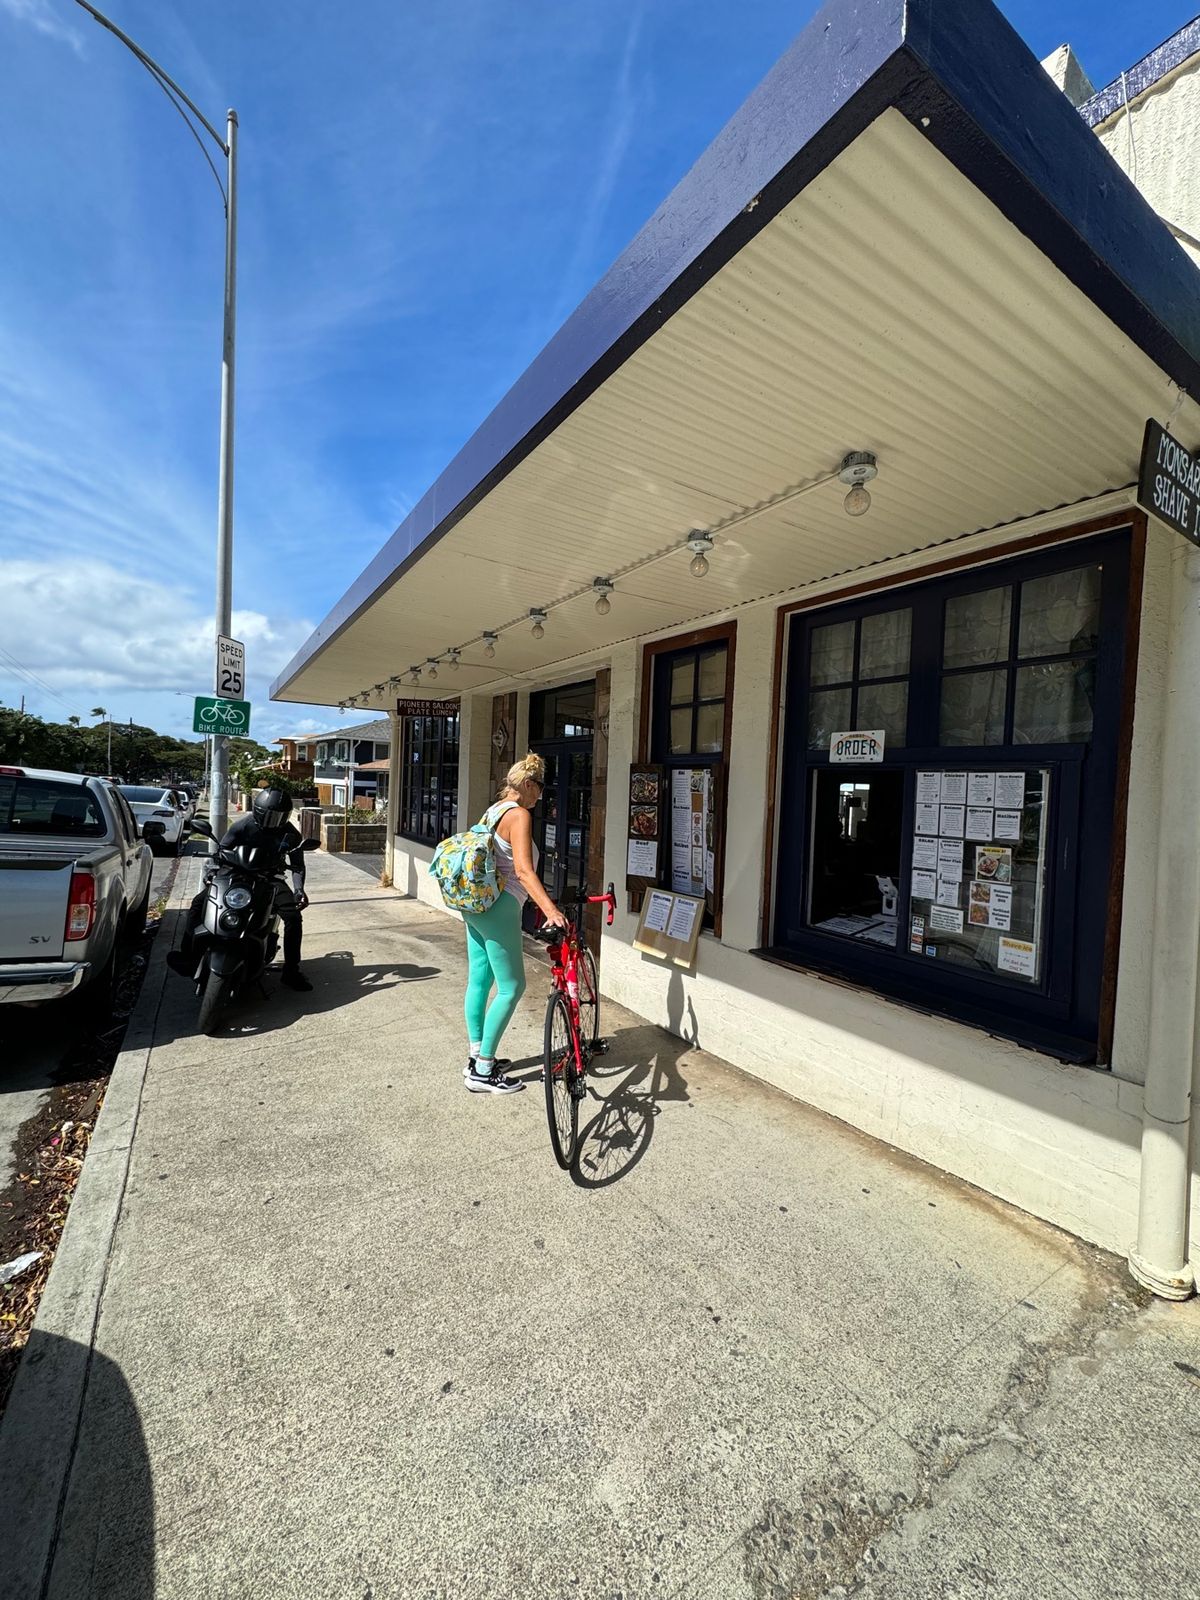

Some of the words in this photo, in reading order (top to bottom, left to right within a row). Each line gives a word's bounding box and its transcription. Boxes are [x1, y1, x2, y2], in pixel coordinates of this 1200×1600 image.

[1153, 474, 1190, 529] SHAVE
[220, 643, 242, 658] SPEED
[223, 656, 240, 670] LIMIT
[221, 670, 242, 694] 25
[400, 700, 430, 708] PIONEER
[198, 724, 216, 733] BIKE
[220, 725, 243, 734] ROUTE
[836, 739, 876, 756] ORDER
[570, 834, 581, 845] OPE
[29, 936, 51, 944] SV
